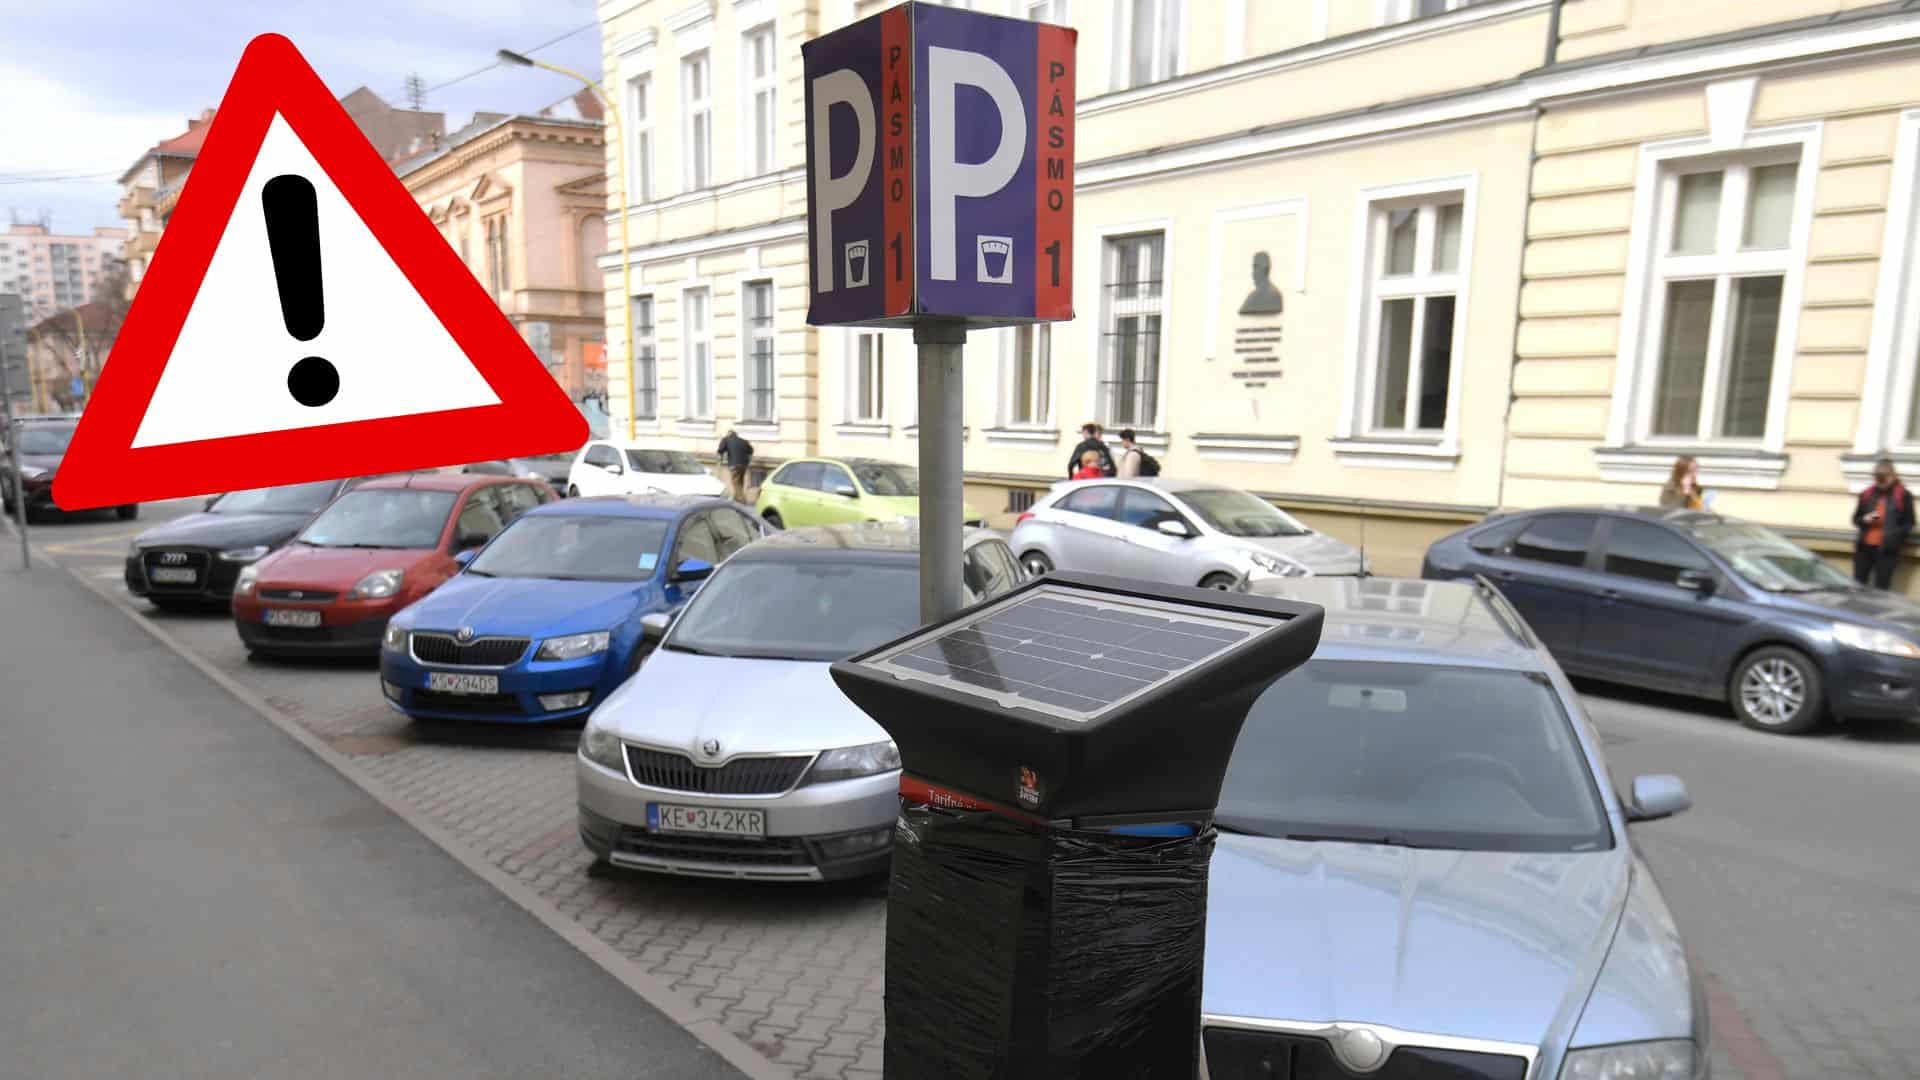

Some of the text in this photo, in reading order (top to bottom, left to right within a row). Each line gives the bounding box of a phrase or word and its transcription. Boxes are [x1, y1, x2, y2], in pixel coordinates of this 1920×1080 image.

[813, 68, 876, 294] P
[891, 231, 903, 281] 1
[928, 45, 1027, 281] P
[1045, 61, 1065, 287] PÁSMO 1
